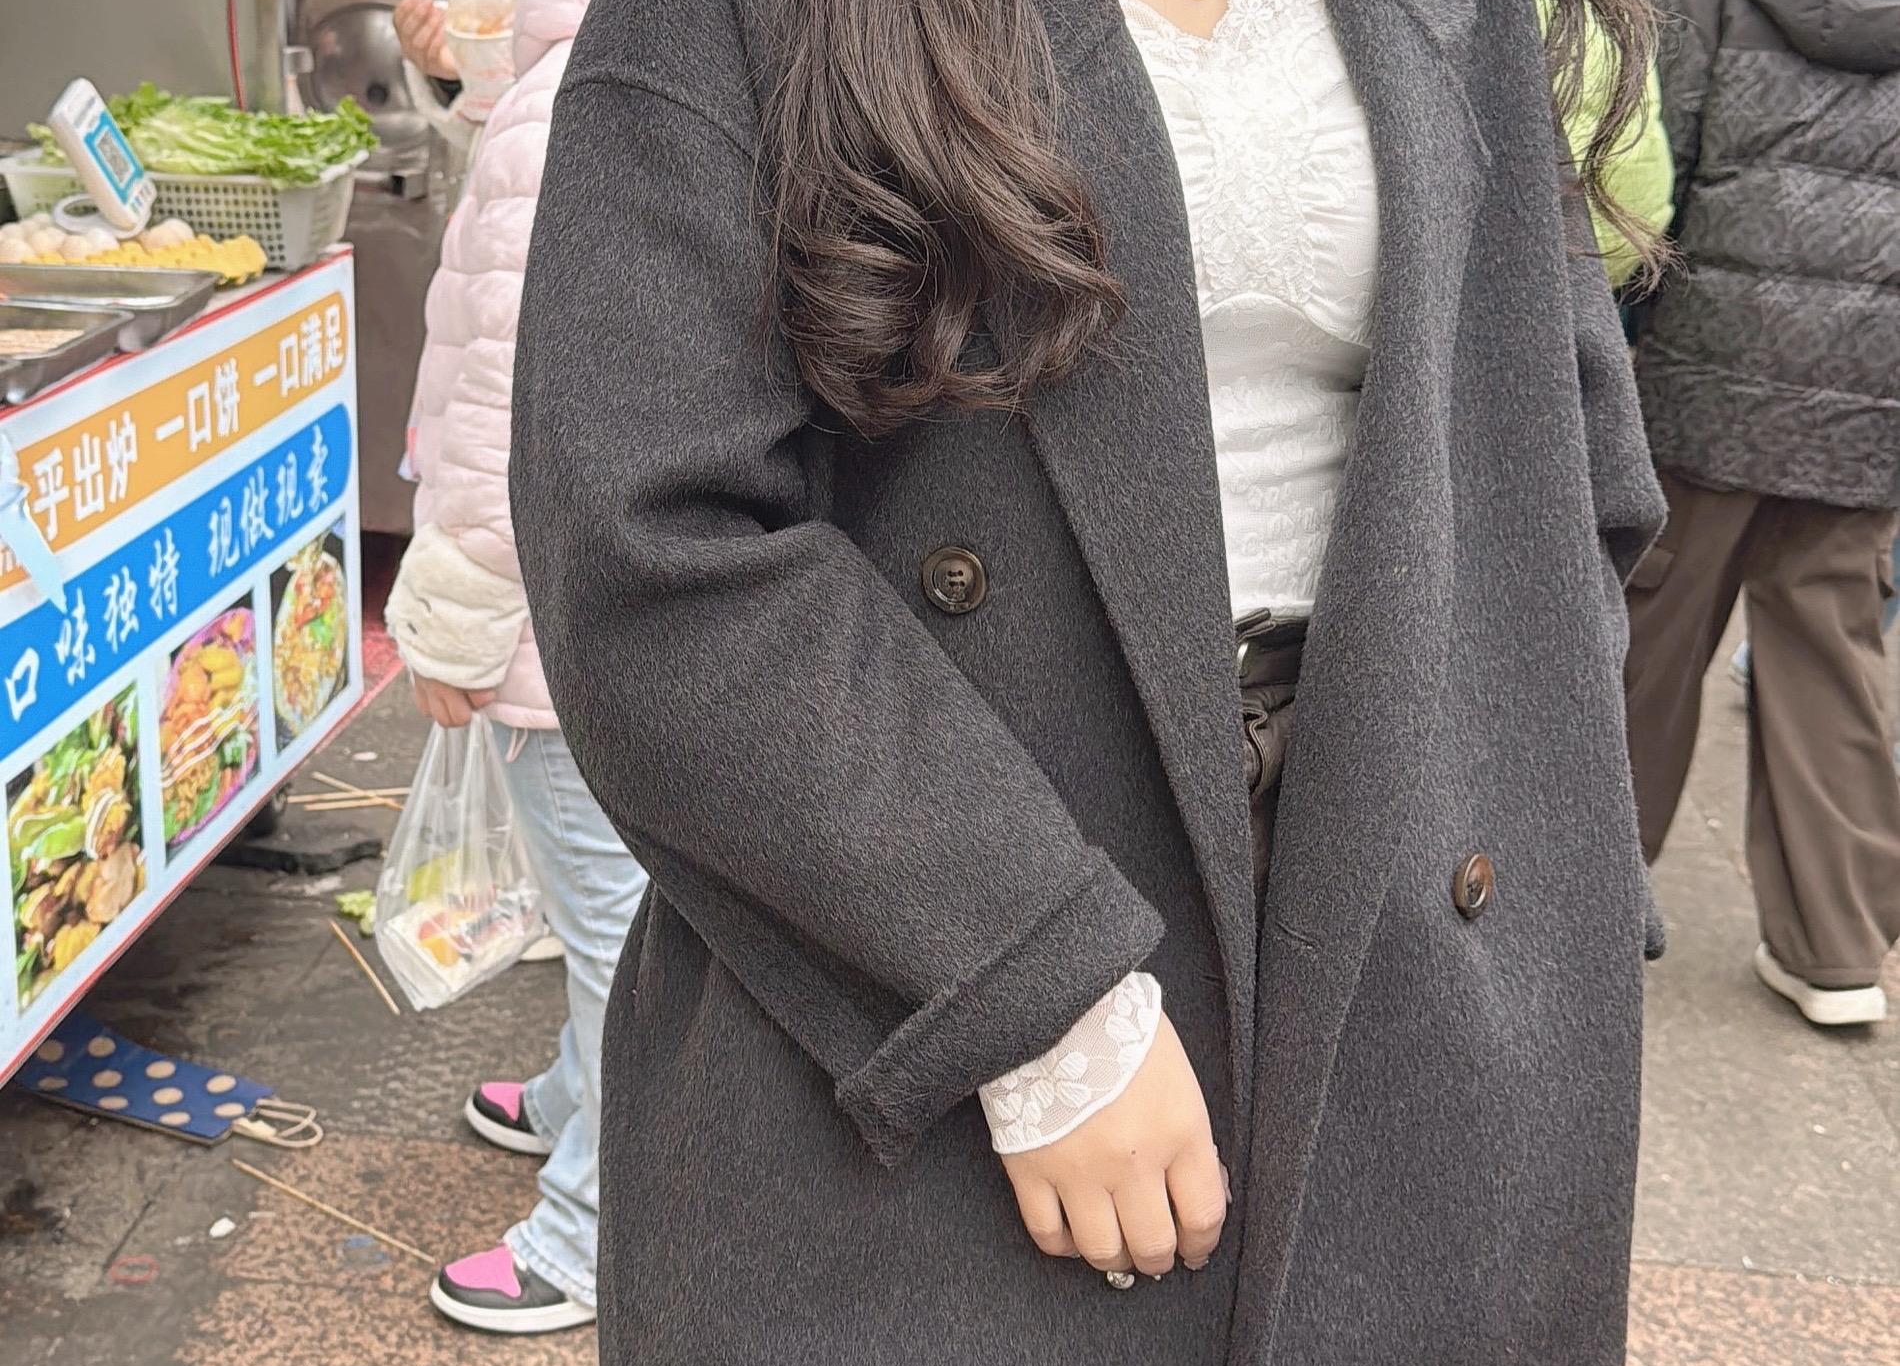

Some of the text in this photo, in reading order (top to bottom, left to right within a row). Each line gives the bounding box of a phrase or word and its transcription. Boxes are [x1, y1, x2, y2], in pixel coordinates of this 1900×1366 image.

[0, 304, 346, 578] 乎出炉 一口饼 一口满足
[5, 425, 330, 722] 口味独特 现做现卖
